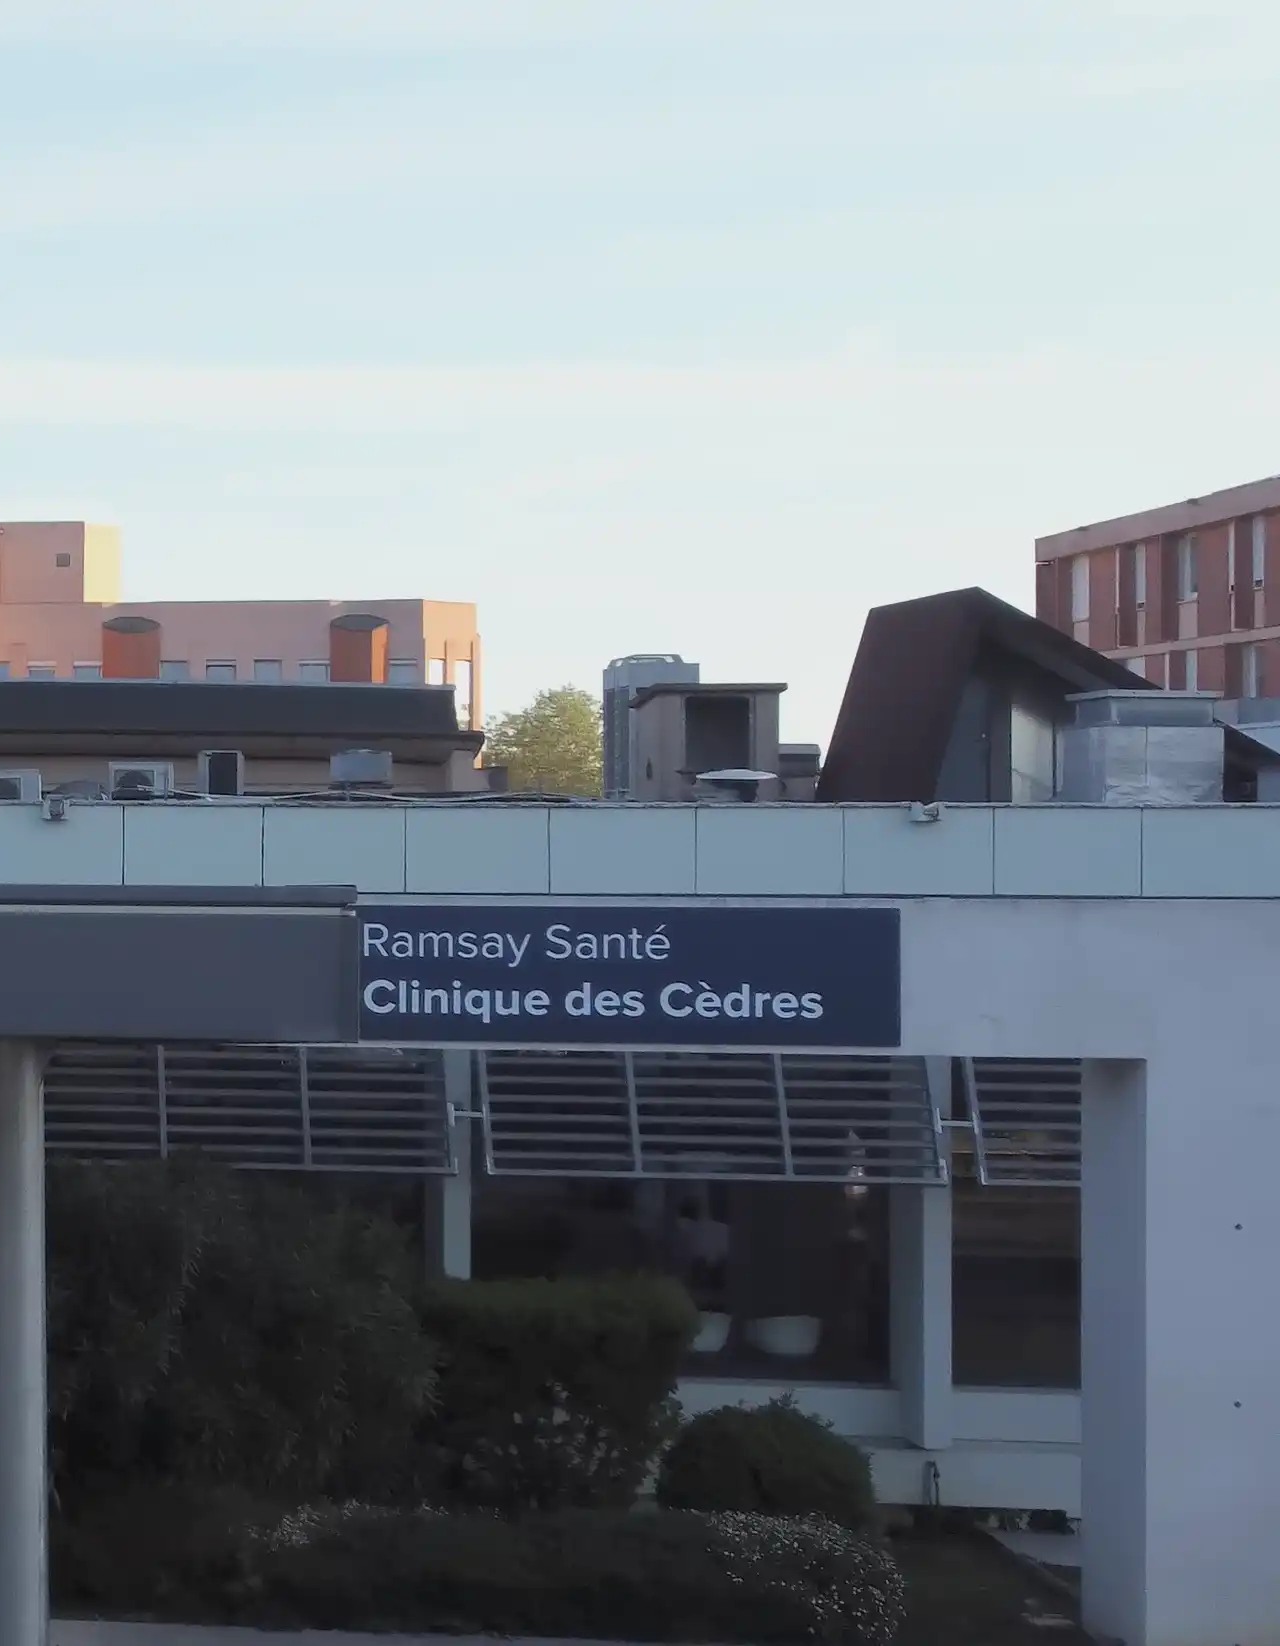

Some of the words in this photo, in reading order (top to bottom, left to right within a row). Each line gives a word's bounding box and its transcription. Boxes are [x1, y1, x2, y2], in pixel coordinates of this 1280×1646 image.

[363, 923, 531, 968] Ramsay
[546, 924, 671, 960] Santé
[363, 979, 550, 1024] Clinique
[564, 982, 646, 1017] des
[659, 981, 824, 1019] Cèdres
